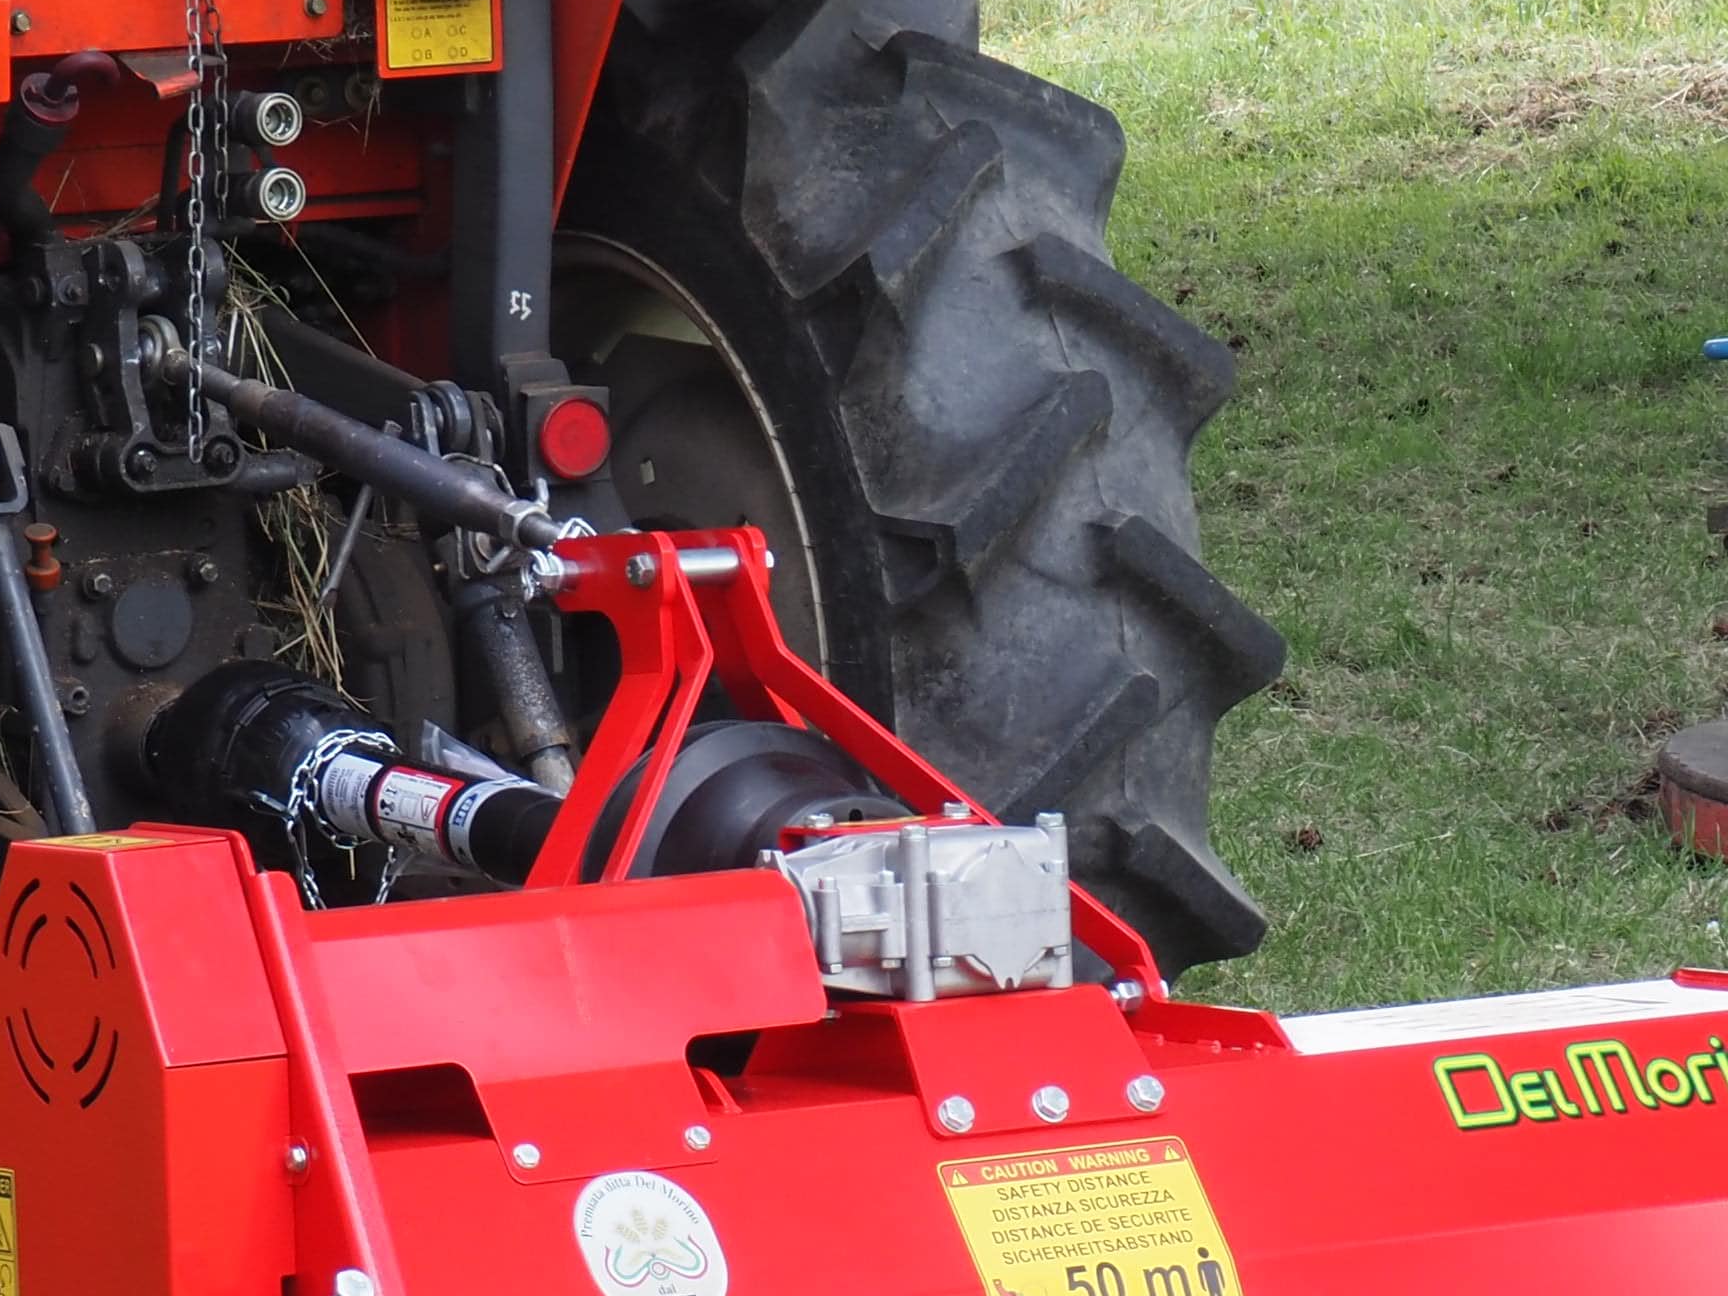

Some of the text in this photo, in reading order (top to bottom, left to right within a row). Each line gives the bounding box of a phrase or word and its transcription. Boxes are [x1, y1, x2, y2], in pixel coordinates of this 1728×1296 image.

[981, 1147, 1152, 1181] CAUTION WARNING
[996, 1170, 1153, 1202] SAFETY DISTANCE
[580, 1174, 700, 1238] Premiata ditta Del Morino
[992, 1188, 1176, 1223] DISTANZA SICUREZZA
[992, 1207, 1193, 1245] DISTANCE DE SECURITE
[1002, 1229, 1195, 1266] SICHERHEITSABSTAND
[658, 1283, 677, 1296] dal
